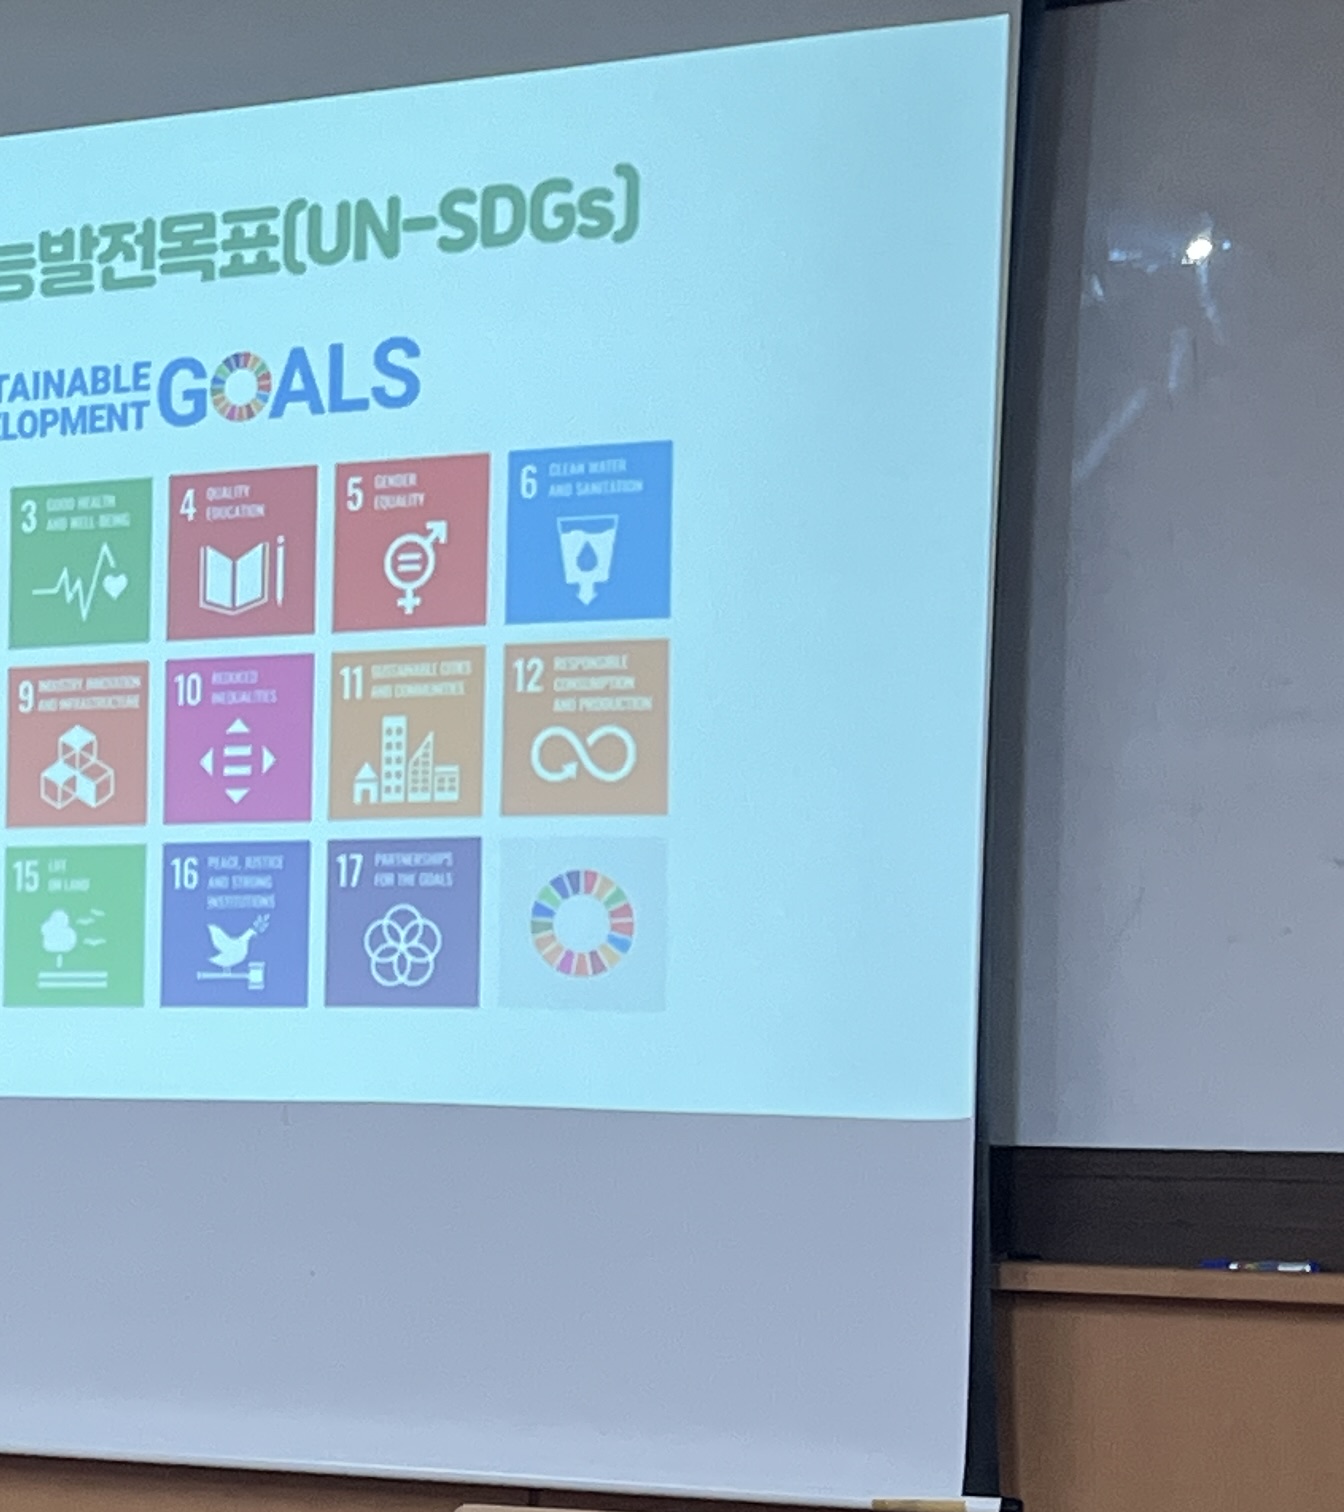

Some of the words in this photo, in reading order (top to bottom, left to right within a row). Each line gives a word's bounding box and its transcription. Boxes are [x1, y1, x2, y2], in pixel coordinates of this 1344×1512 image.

[158, 336, 421, 428] GOALS
[374, 472, 417, 490] GENDER
[520, 464, 538, 499] 6
[548, 462, 585, 477] CLEAN
[588, 458, 627, 474] WATER
[179, 488, 197, 522] 4
[206, 484, 249, 502] QUALITY
[346, 475, 364, 512] 5
[374, 492, 426, 511] EQUALITY
[548, 483, 573, 497] AND
[20, 499, 38, 534] 3
[206, 503, 265, 522] EDUCATION
[173, 671, 202, 707] 10
[339, 664, 364, 701] 11
[513, 656, 545, 693] 12
[18, 680, 35, 714] 9
[12, 859, 40, 893] 15
[64, 878, 90, 891] LAND
[170, 856, 199, 890] 16
[336, 853, 364, 888] 17
[374, 872, 395, 887] FOR
[418, 872, 453, 887] GOALS
